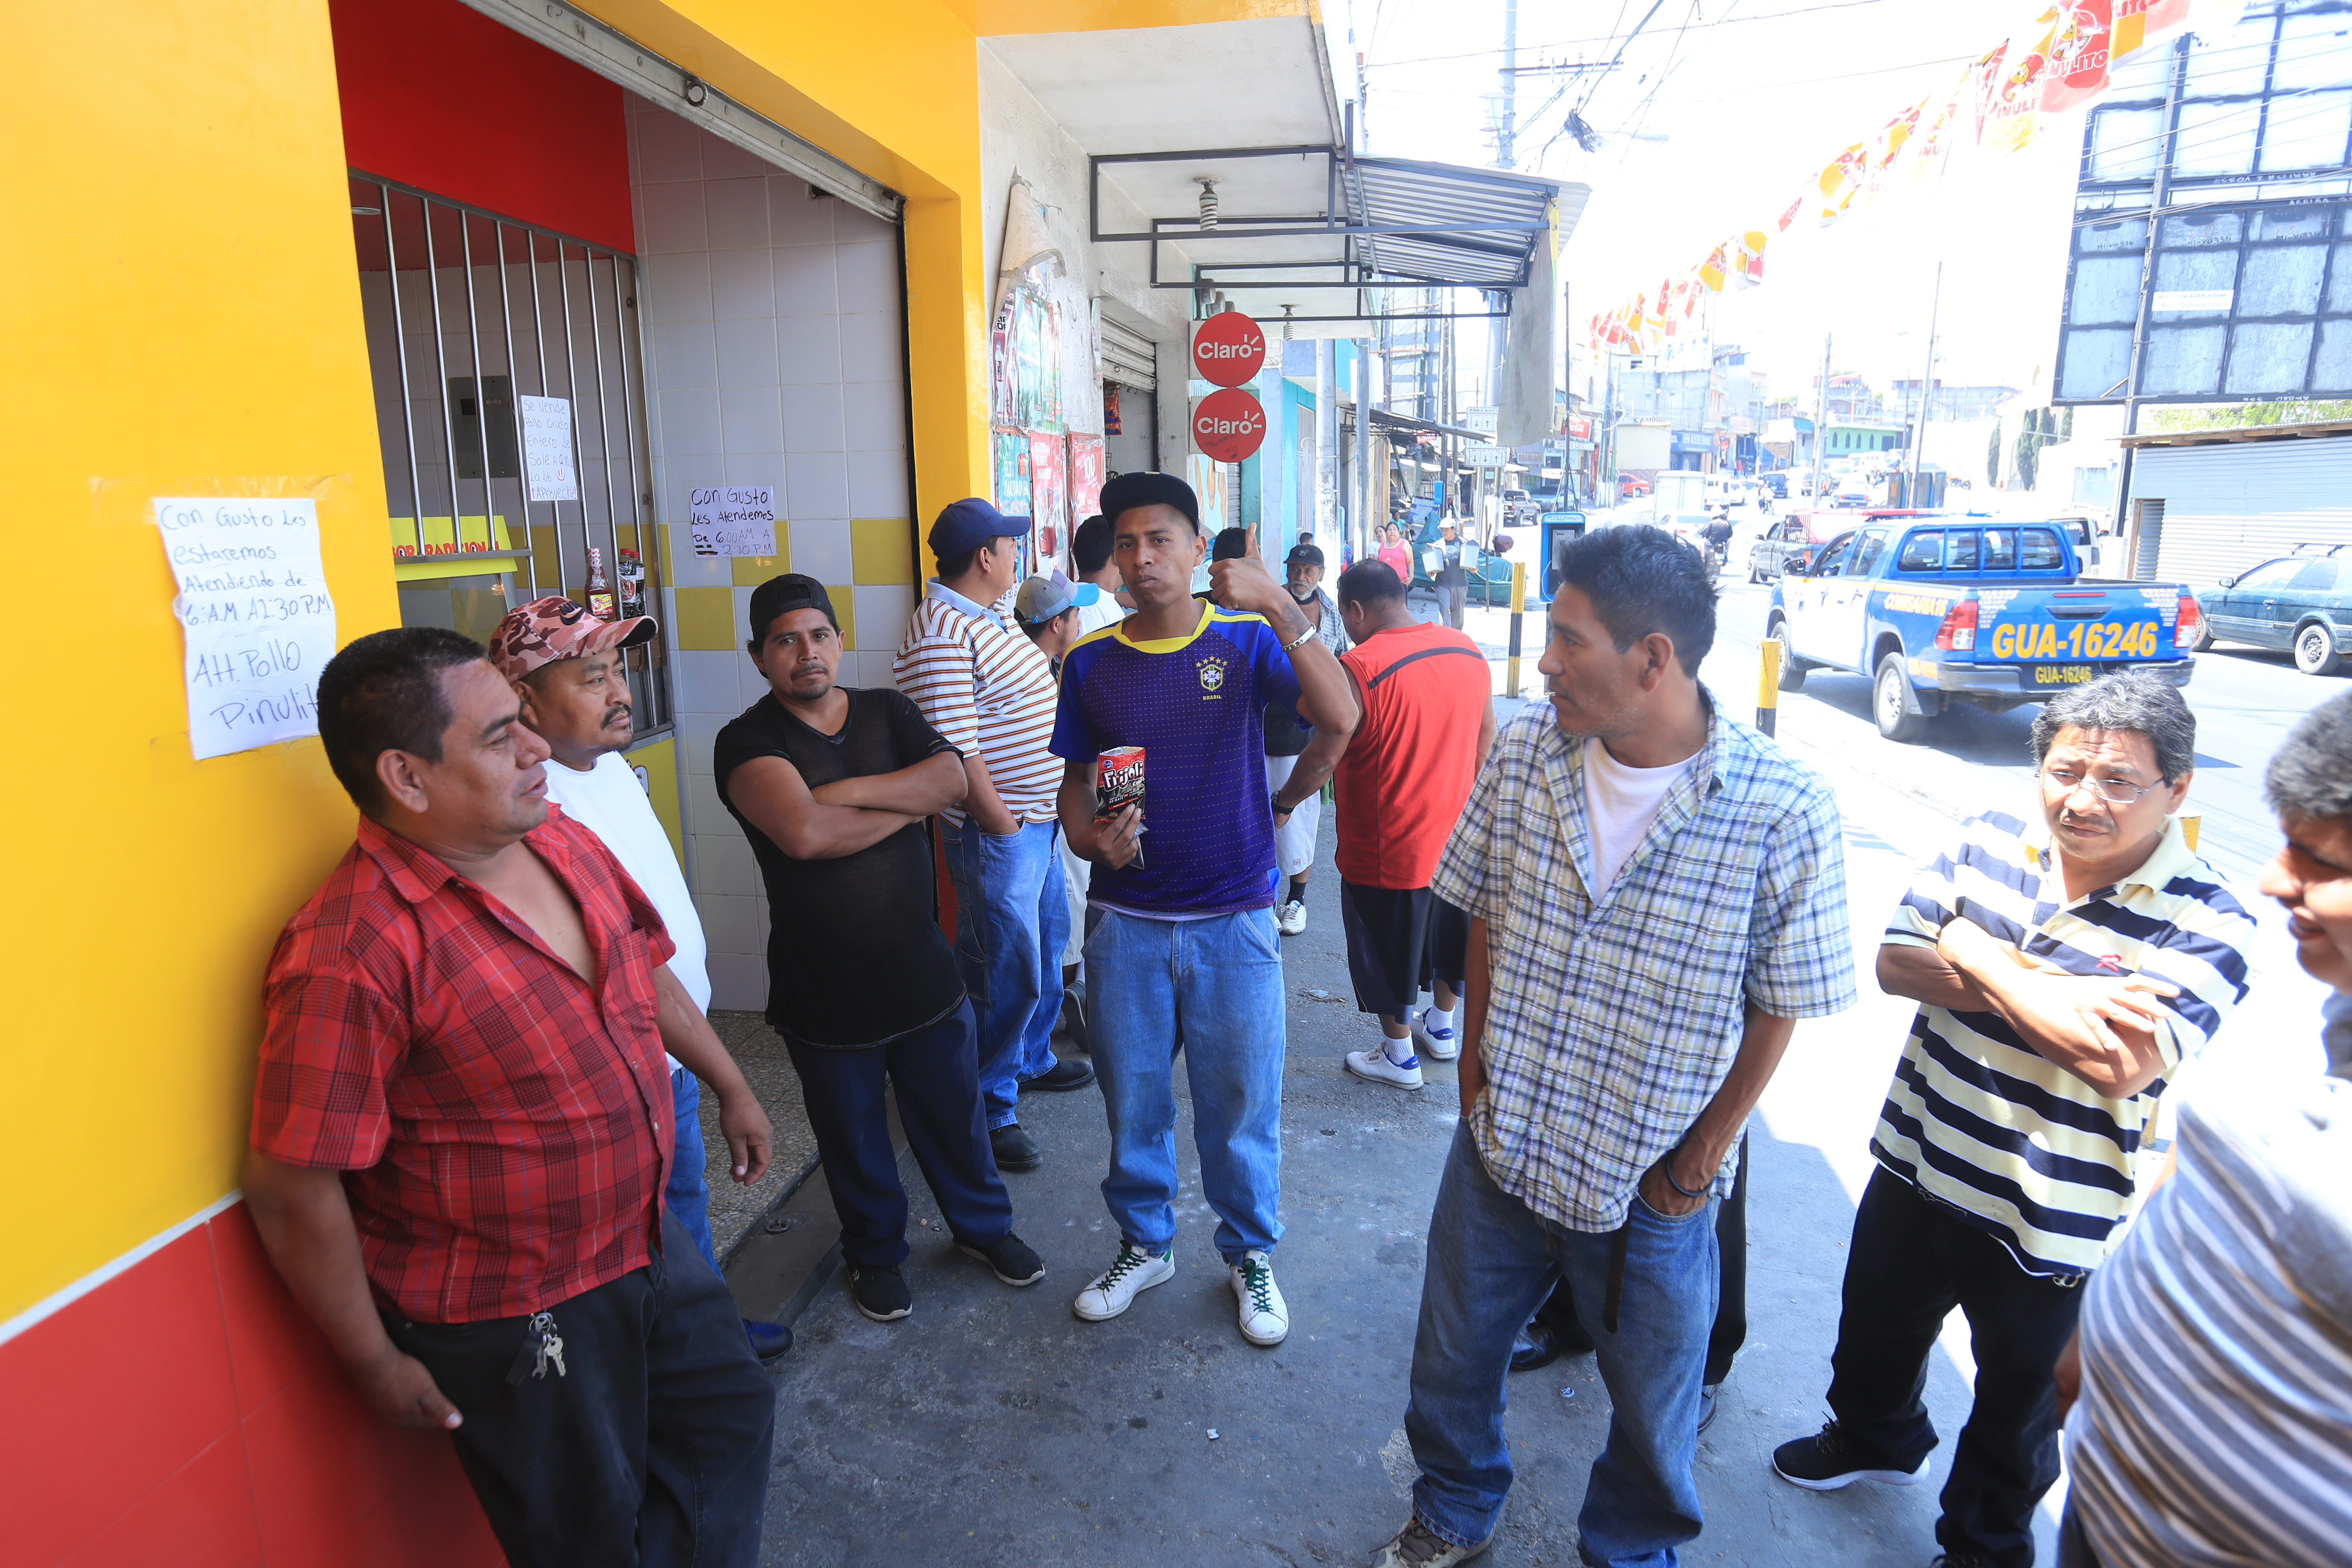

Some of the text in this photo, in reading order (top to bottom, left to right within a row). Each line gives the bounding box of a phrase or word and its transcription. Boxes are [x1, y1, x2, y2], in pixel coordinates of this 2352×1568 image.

[1197, 342, 1253, 359] Claro
[1197, 416, 1253, 435] Claro
[691, 487, 768, 506] Con Gusto
[161, 505, 204, 530] Con
[216, 506, 273, 527] Gusto
[691, 512, 711, 526] Les
[722, 544, 750, 555] 2:30
[1992, 622, 2159, 658] GUA-16246
[238, 638, 301, 678] Pollo
[209, 683, 318, 730] Pinulit
